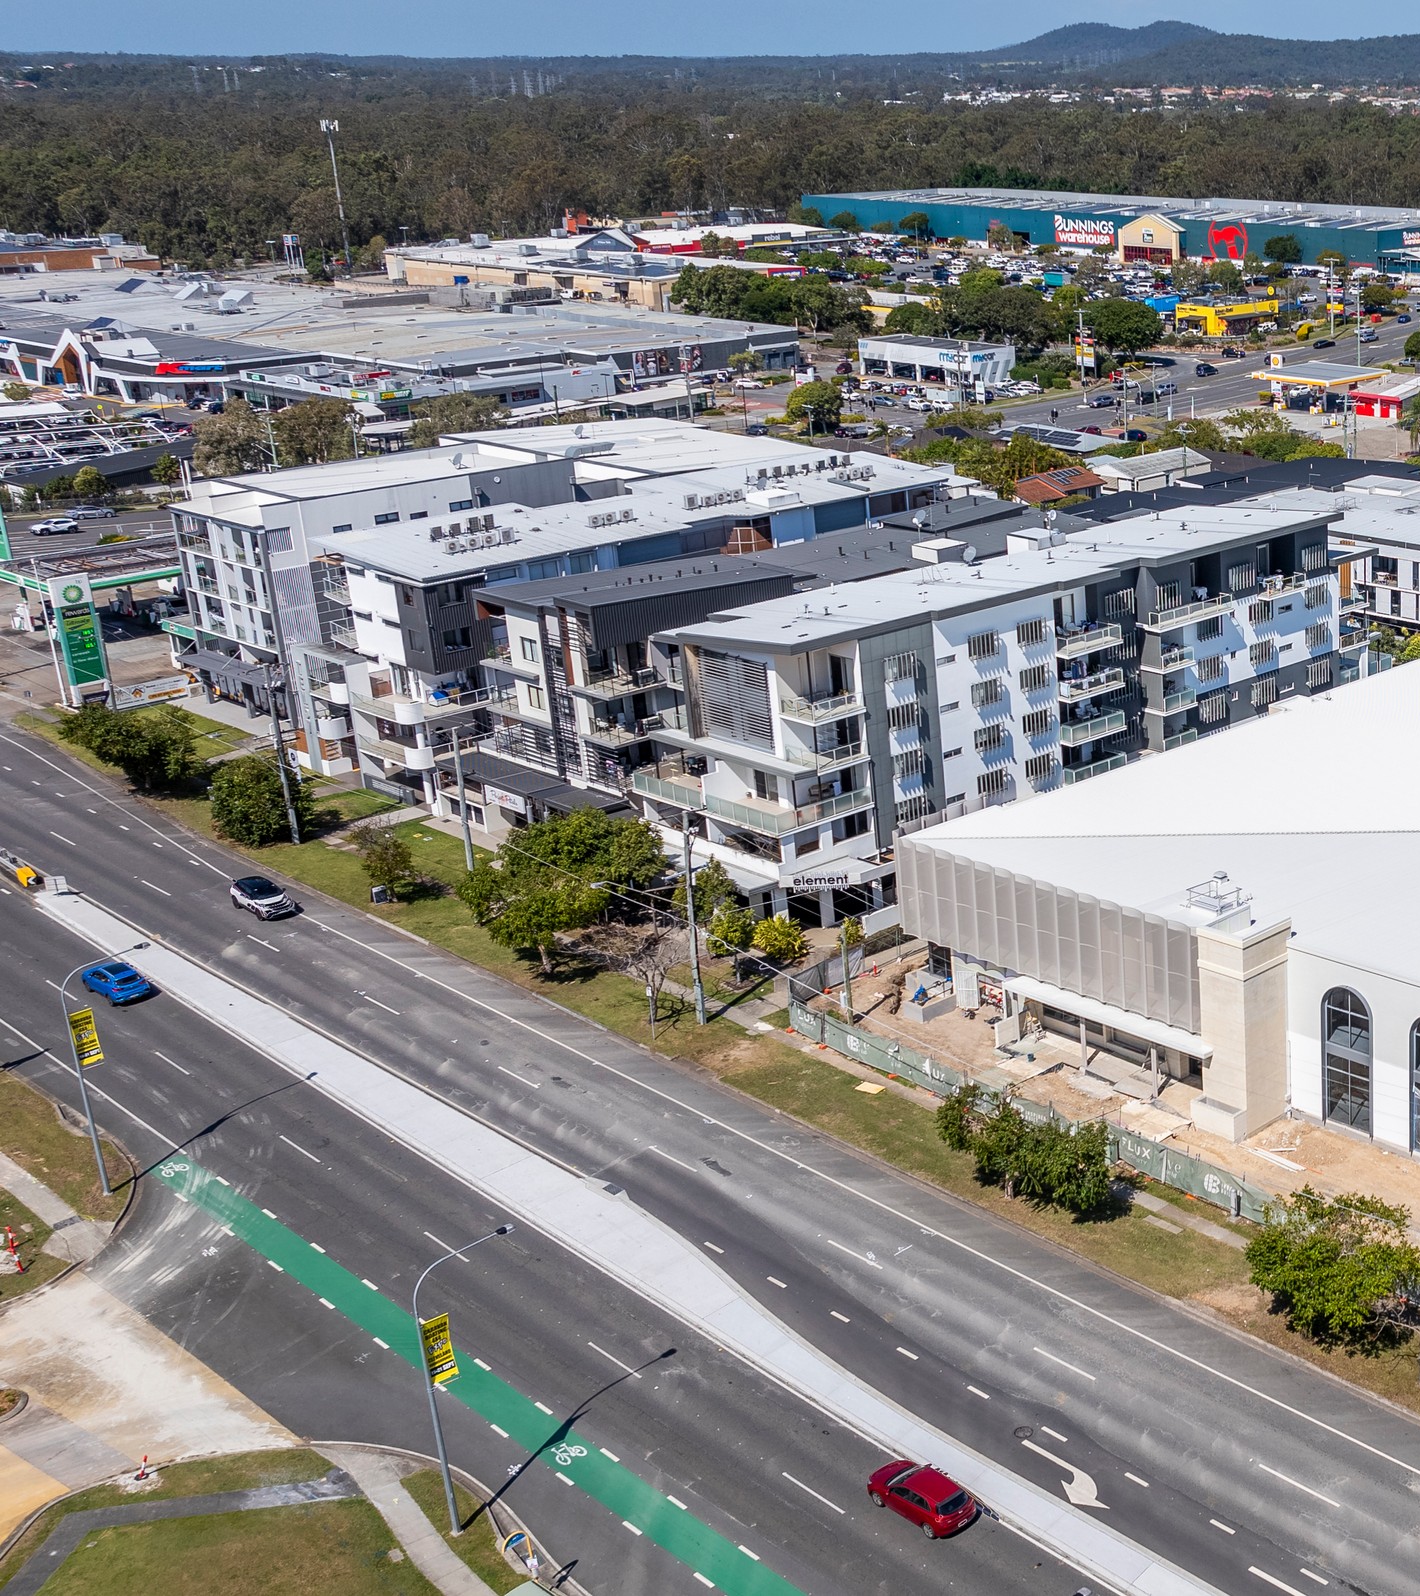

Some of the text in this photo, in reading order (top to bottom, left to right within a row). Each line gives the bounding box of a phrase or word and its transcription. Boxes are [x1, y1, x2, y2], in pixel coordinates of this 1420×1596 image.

[1054, 214, 1115, 235] BUNNINGS
[764, 233, 781, 242] rebel
[1058, 231, 1111, 245] warehouse
[938, 351, 968, 364] mycar
[972, 351, 997, 363] mycar
[155, 362, 223, 375] Kmart
[64, 607, 90, 617] rewards
[793, 874, 849, 886] element
